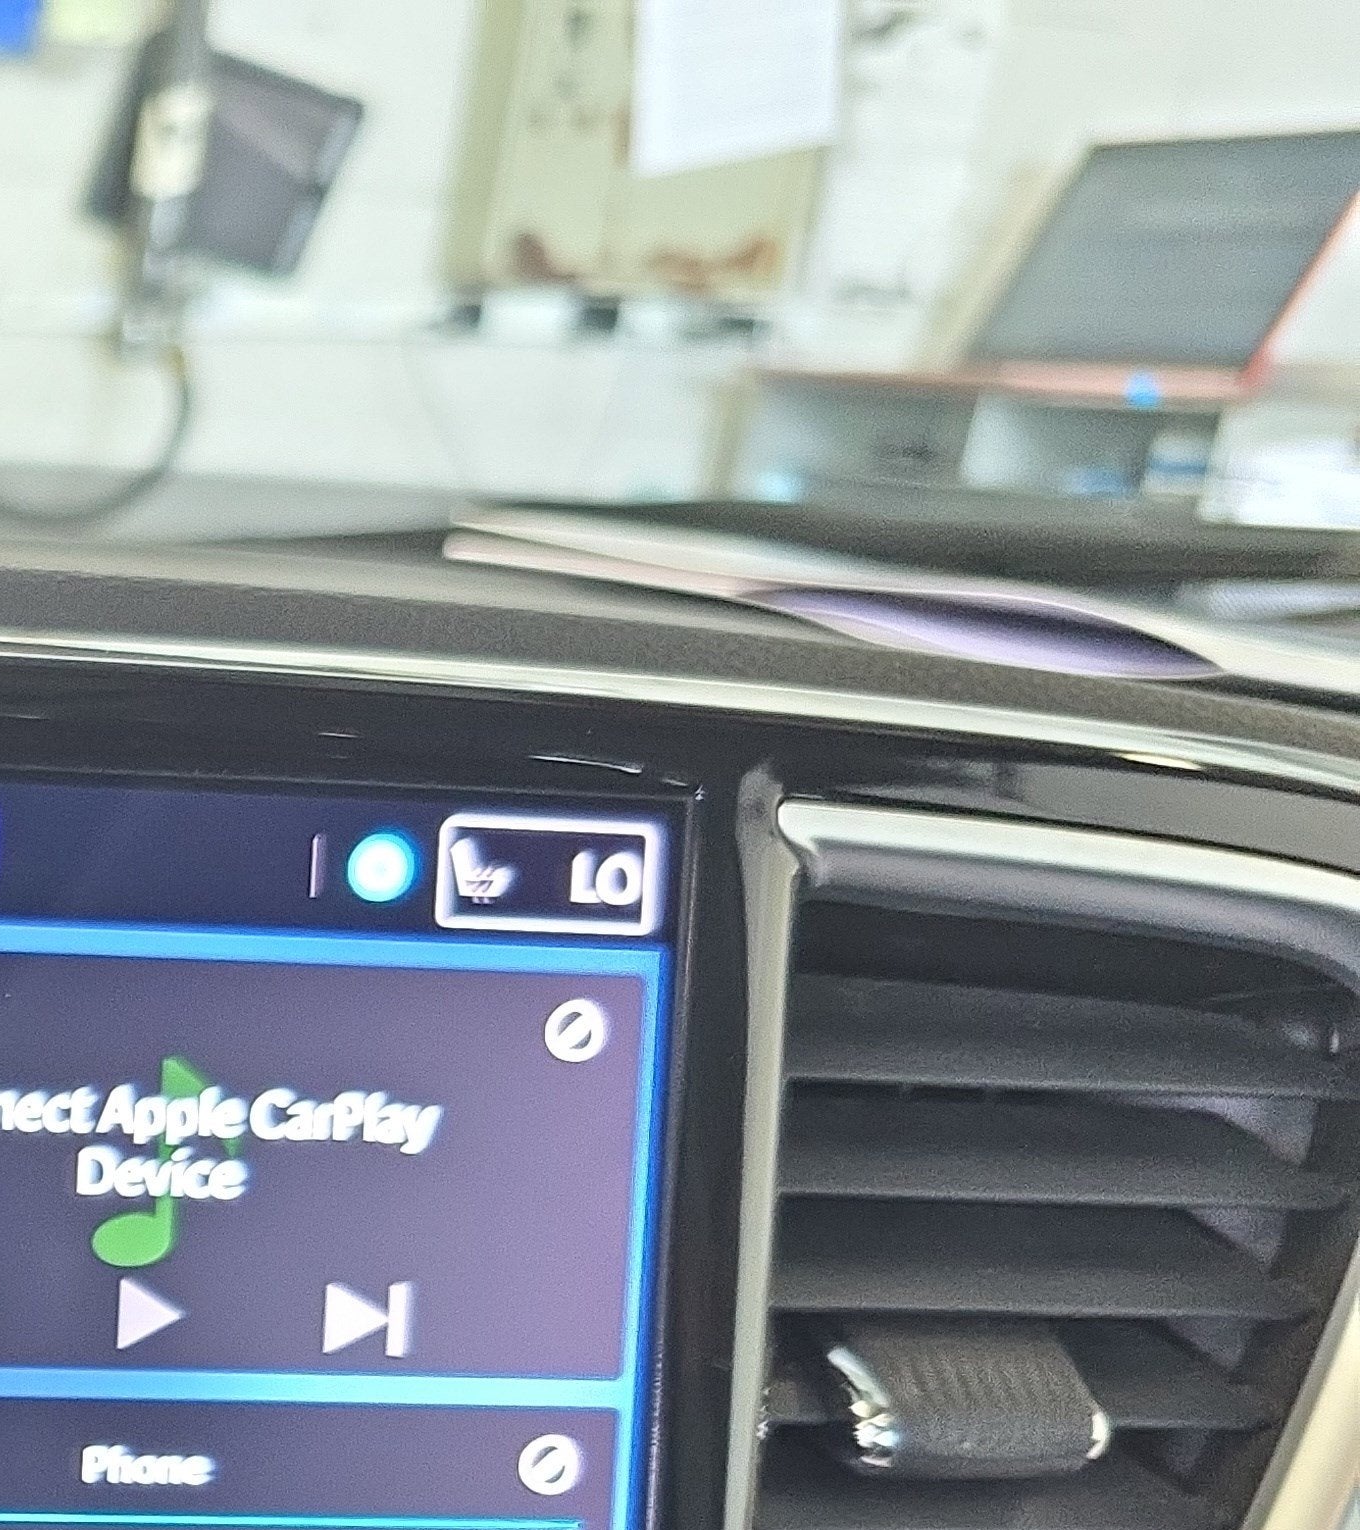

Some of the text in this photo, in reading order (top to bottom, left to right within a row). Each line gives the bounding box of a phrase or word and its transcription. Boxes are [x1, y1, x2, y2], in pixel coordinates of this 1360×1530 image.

[569, 850, 643, 906] LO
[95, 1082, 250, 1144] Apple
[249, 1086, 444, 1156] CarPlay
[76, 1145, 252, 1200] Device
[81, 1444, 216, 1486] Phone
